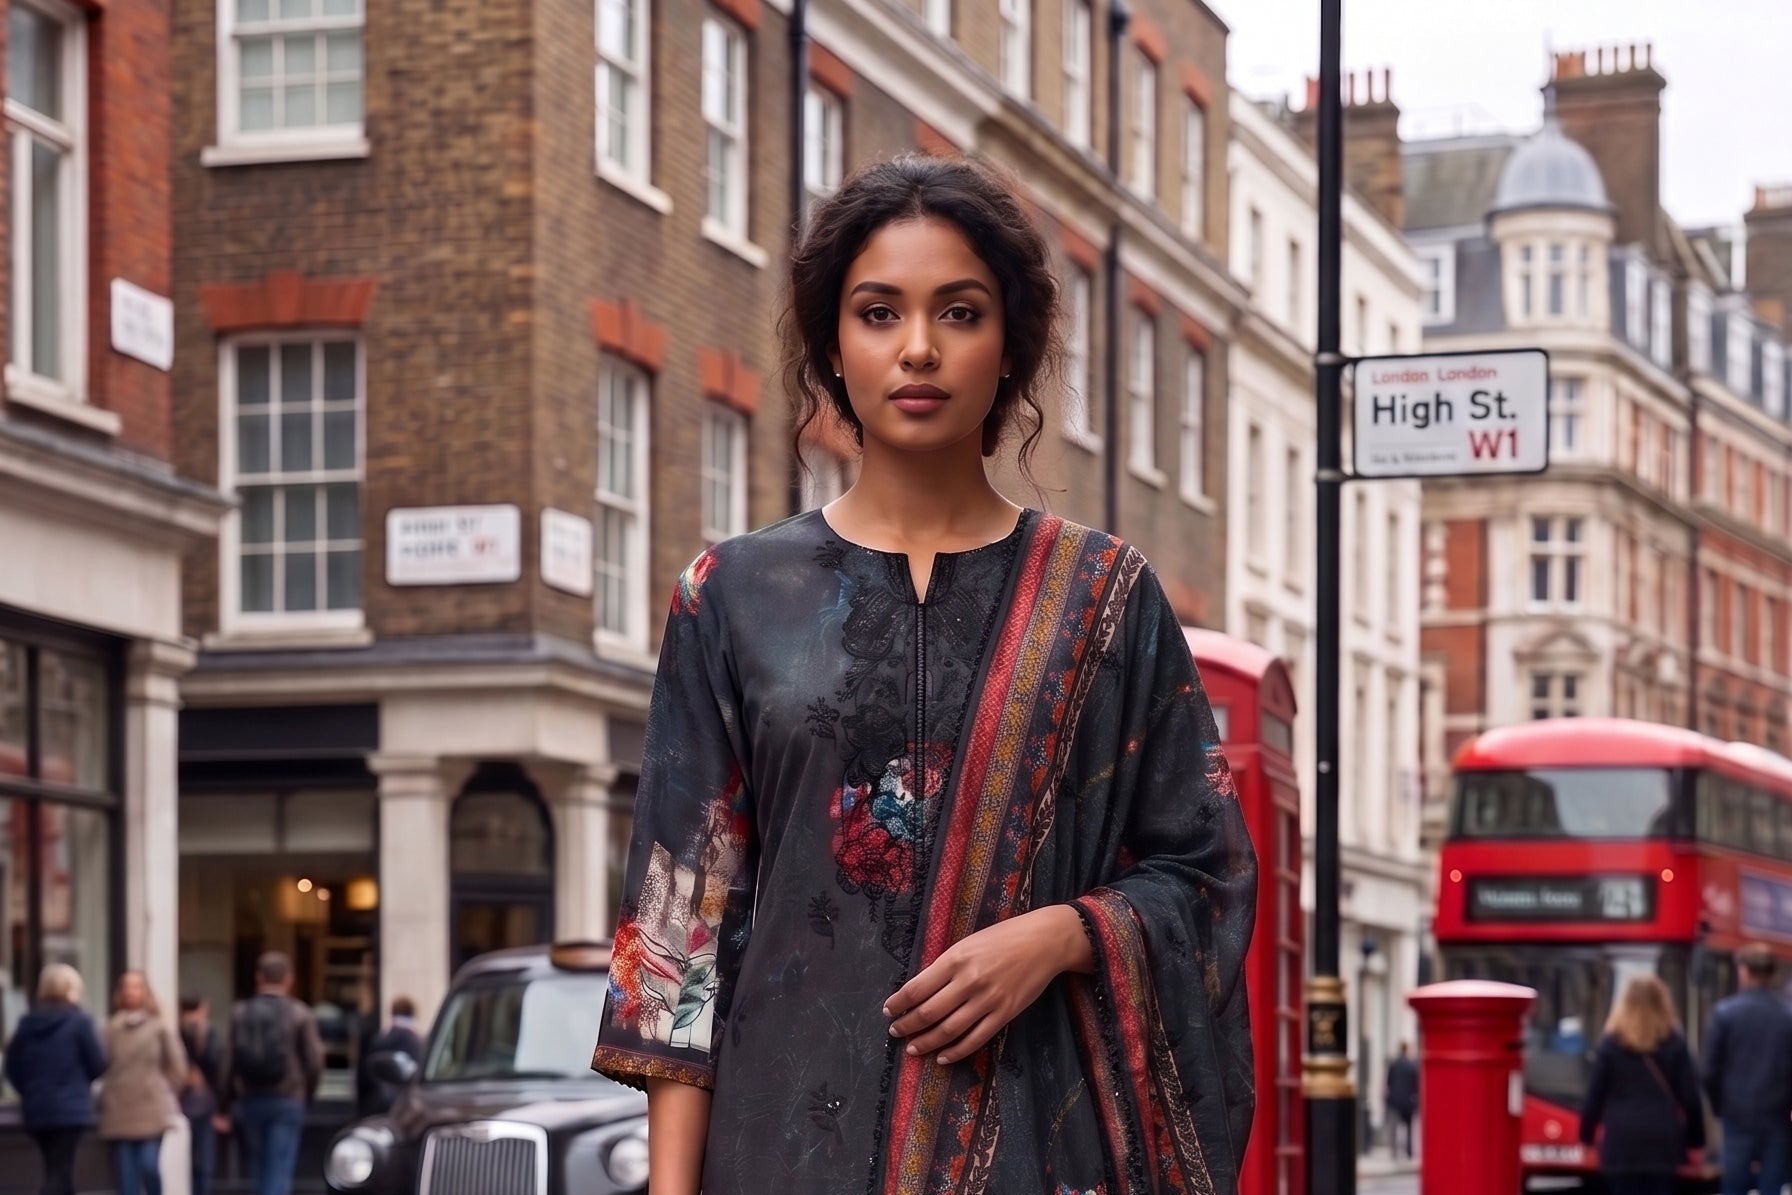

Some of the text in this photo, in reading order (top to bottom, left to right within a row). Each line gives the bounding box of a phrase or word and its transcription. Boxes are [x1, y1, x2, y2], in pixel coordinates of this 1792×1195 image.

[1372, 389, 1517, 429] High St.
[1469, 428, 1517, 460] W1
